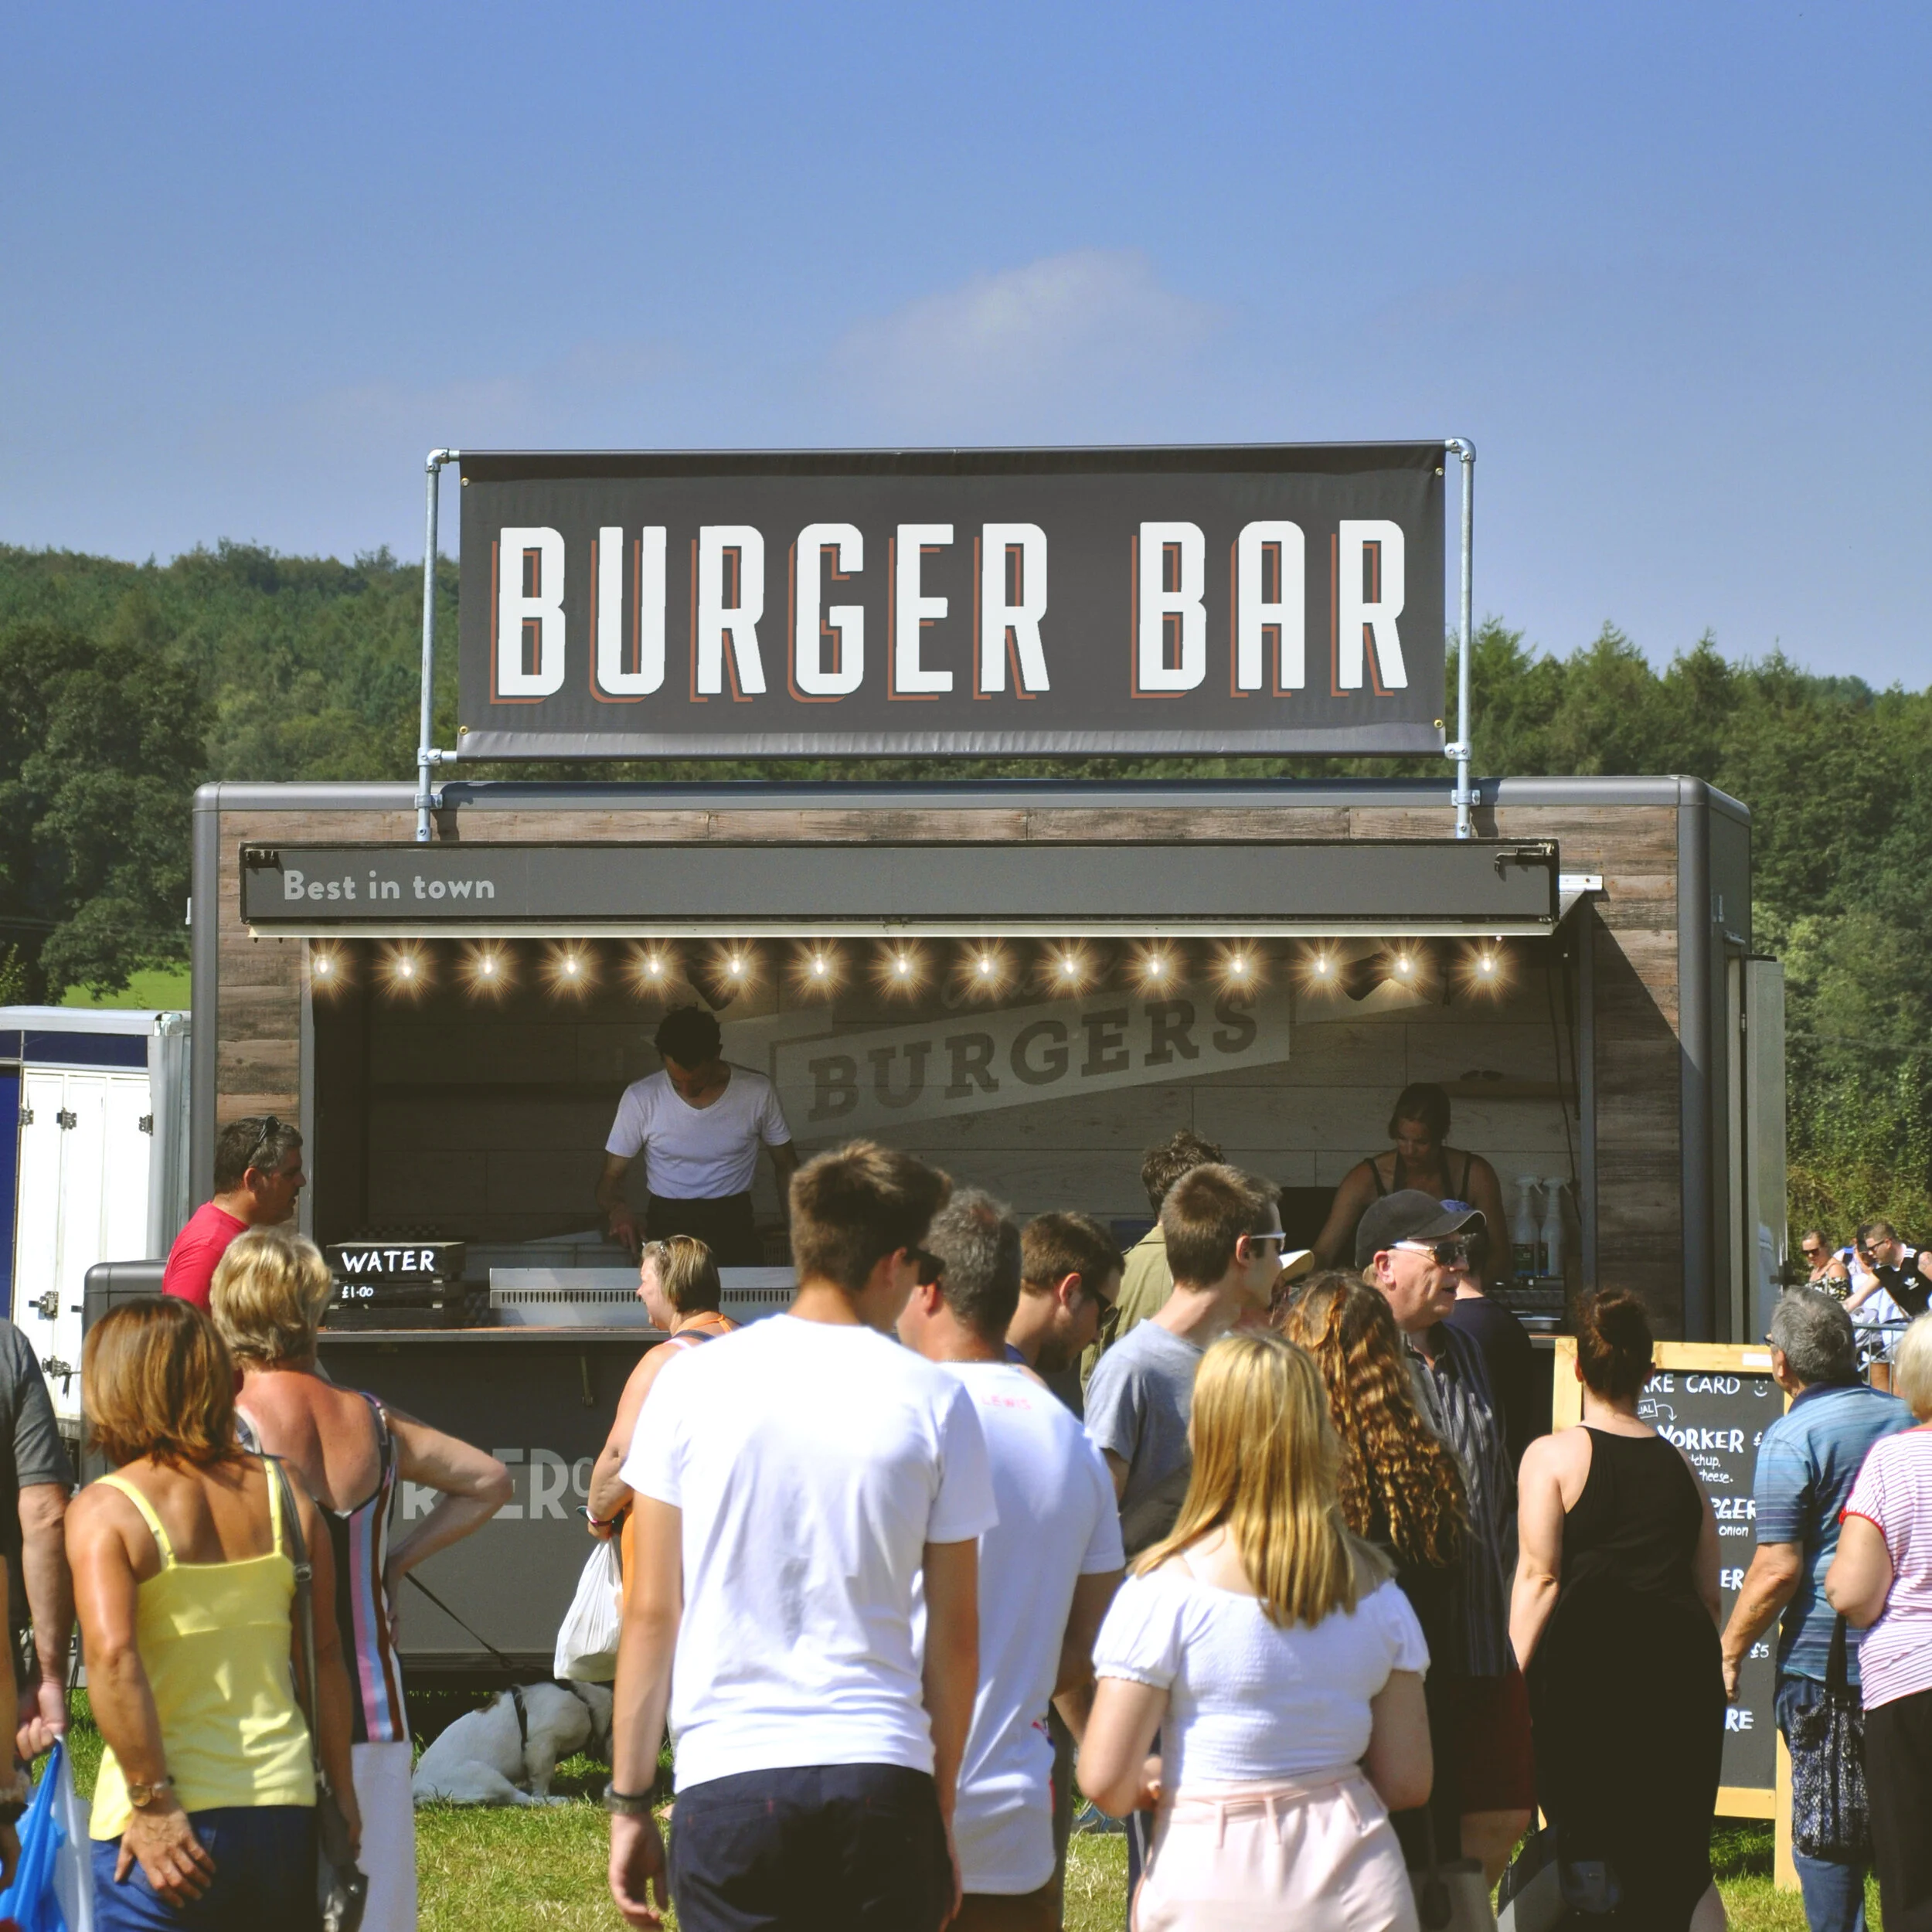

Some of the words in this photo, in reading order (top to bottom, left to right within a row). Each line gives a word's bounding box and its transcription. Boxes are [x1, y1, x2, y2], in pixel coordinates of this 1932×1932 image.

[490, 523, 1049, 704] BURGER
[1131, 519, 1408, 699] BAR
[284, 870, 356, 900] Best
[369, 870, 400, 899] in
[413, 876, 495, 900] town
[808, 995, 1257, 1122] BURGERS
[342, 1250, 434, 1273] WATER
[1686, 1375, 1740, 1395] CARD
[979, 1393, 1032, 1410] LEWIS
[1657, 1425, 1745, 1454] YORKER
[1750, 1642, 1770, 1658] £5
